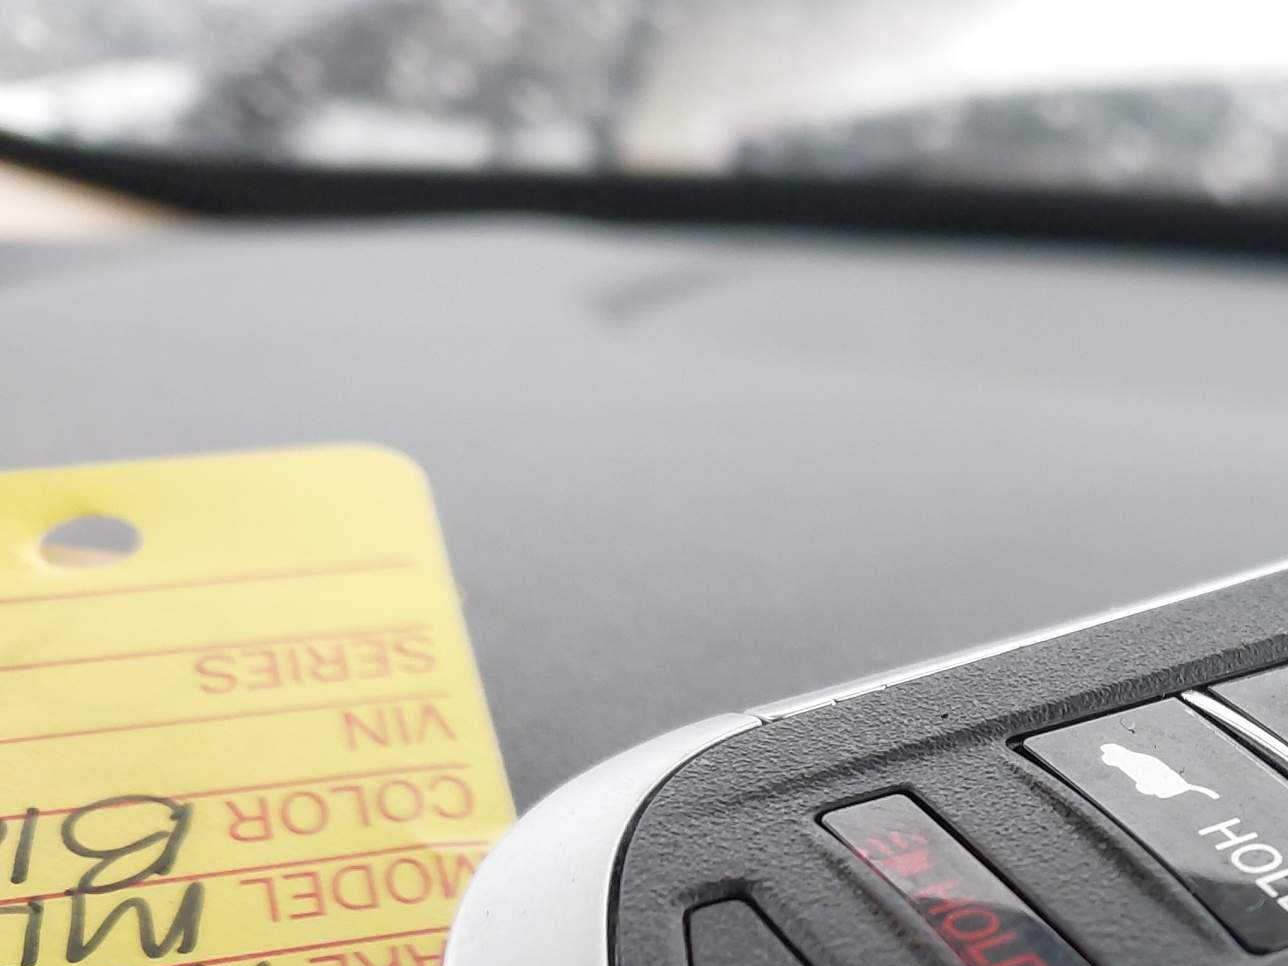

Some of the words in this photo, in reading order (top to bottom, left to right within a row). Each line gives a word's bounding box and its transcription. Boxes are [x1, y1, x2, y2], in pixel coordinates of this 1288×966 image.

[194, 633, 437, 695] SERIES
[343, 702, 458, 751] VIN
[224, 774, 475, 843] COLOR
[0, 794, 194, 895] Bl
[240, 852, 488, 923] MODEL
